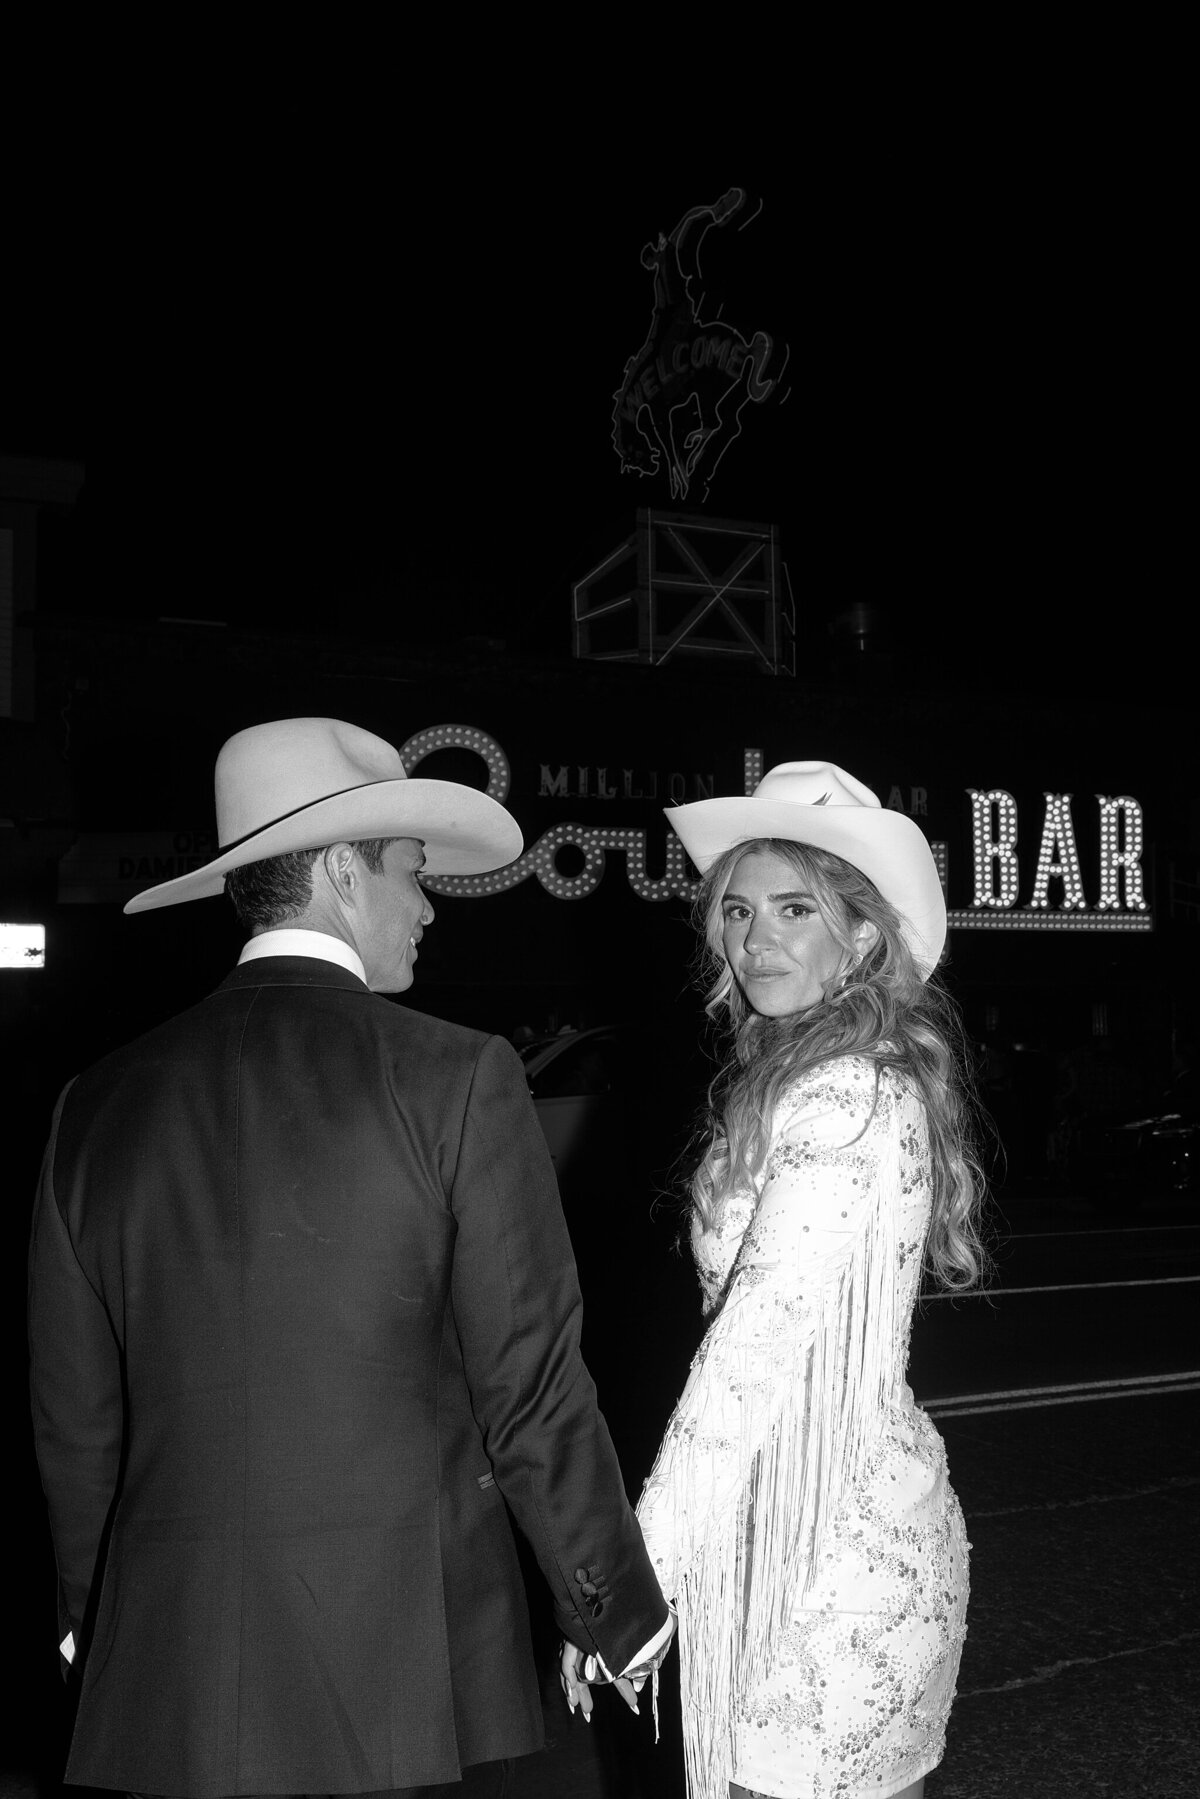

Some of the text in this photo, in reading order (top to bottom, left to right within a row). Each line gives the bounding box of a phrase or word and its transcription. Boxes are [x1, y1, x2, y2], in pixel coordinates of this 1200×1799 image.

[619, 335, 748, 422] WELCOME
[537, 763, 716, 801] MILLION
[964, 788, 1151, 912] BAR
